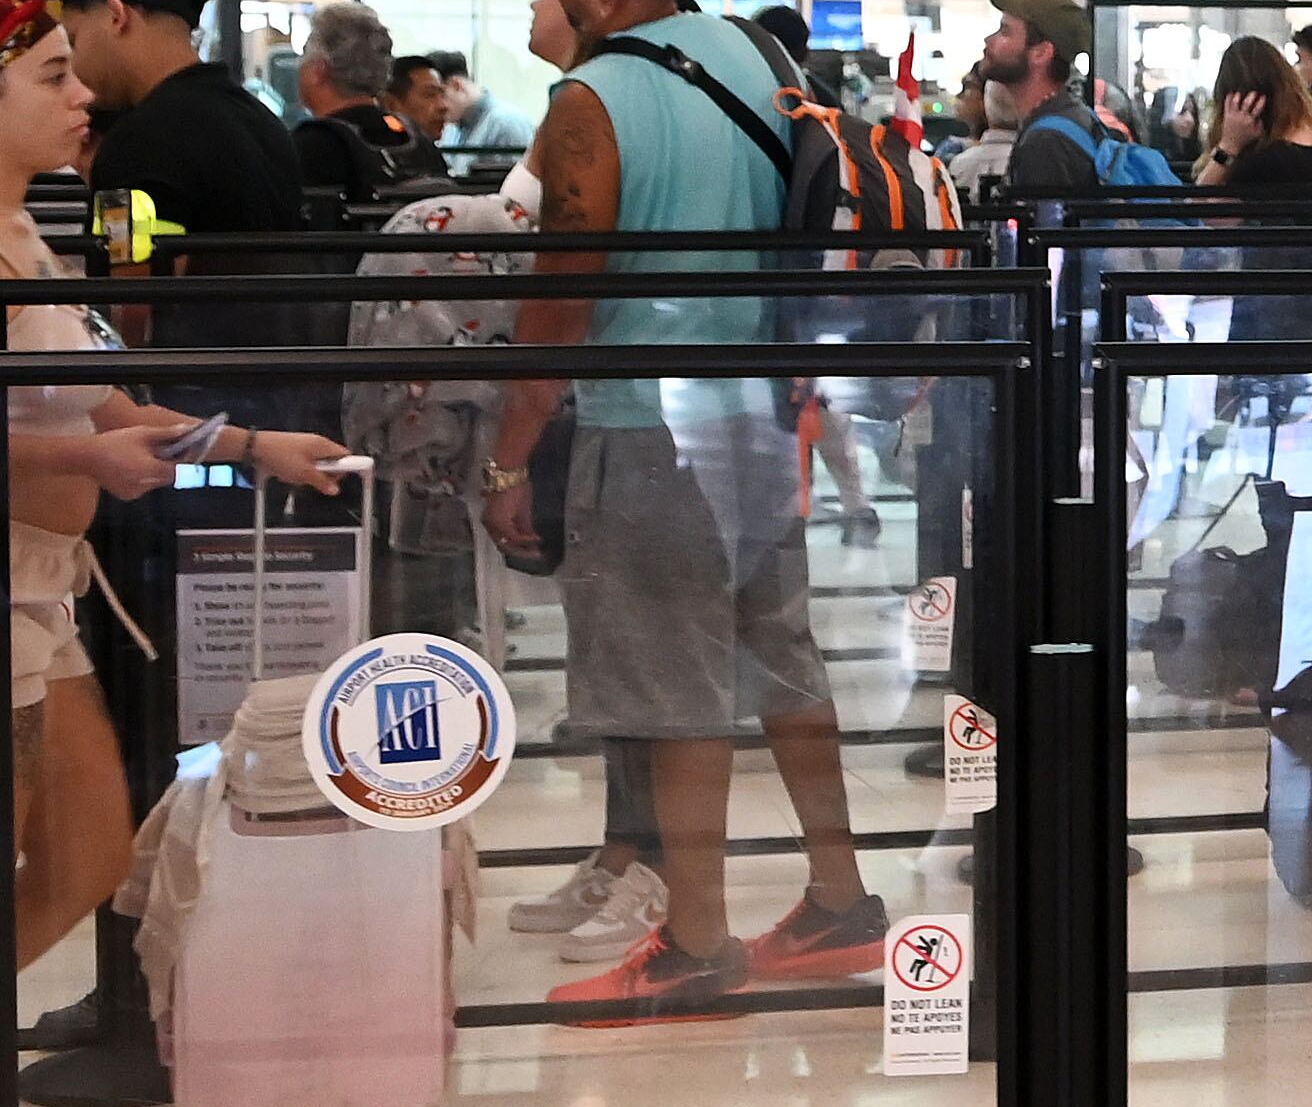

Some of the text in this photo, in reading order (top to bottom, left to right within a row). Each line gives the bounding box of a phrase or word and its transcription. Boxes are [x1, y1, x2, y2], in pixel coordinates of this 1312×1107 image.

[338, 670, 370, 704] AIRPORT
[381, 685, 437, 752] ACI
[949, 756, 961, 766] DO
[963, 756, 979, 765] NOT
[365, 785, 463, 810] ACCREDITED
[890, 998, 962, 1011] DO NOT LEAN
[890, 1013, 905, 1024] NO
[908, 1012, 920, 1023] TE
